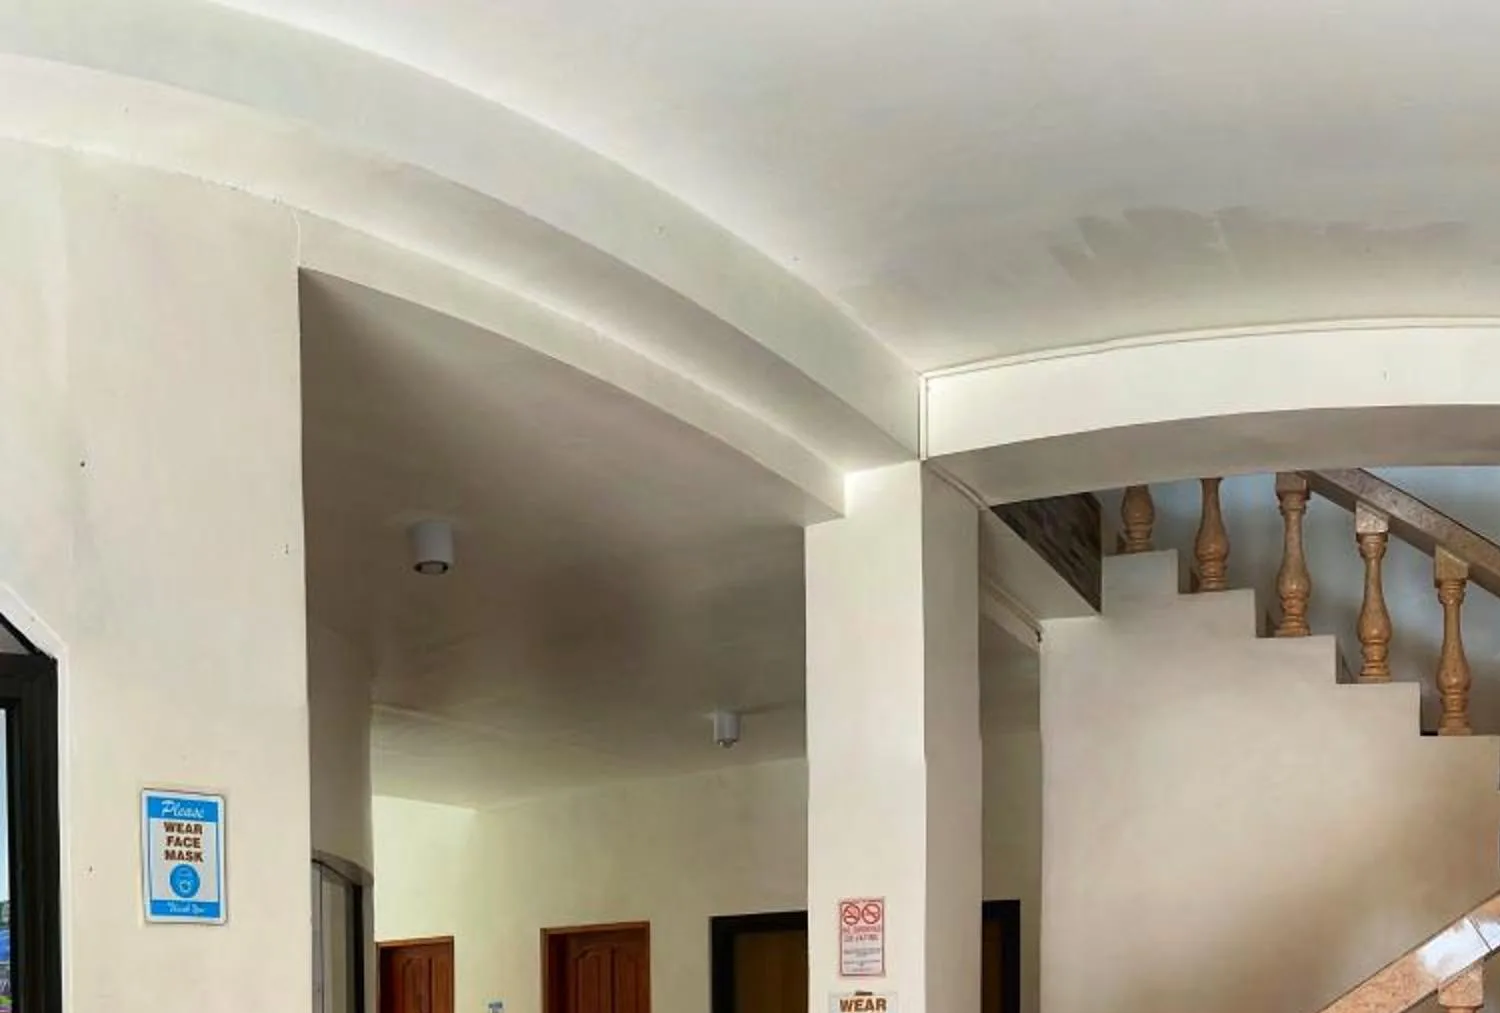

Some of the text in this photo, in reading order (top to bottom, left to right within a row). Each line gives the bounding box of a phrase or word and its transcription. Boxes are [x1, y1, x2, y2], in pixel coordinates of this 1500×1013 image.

[161, 800, 204, 818] Please
[163, 822, 203, 834] WEAR
[166, 836, 201, 848] FACE
[164, 850, 204, 862] MASK
[839, 998, 887, 1013] WEAR
